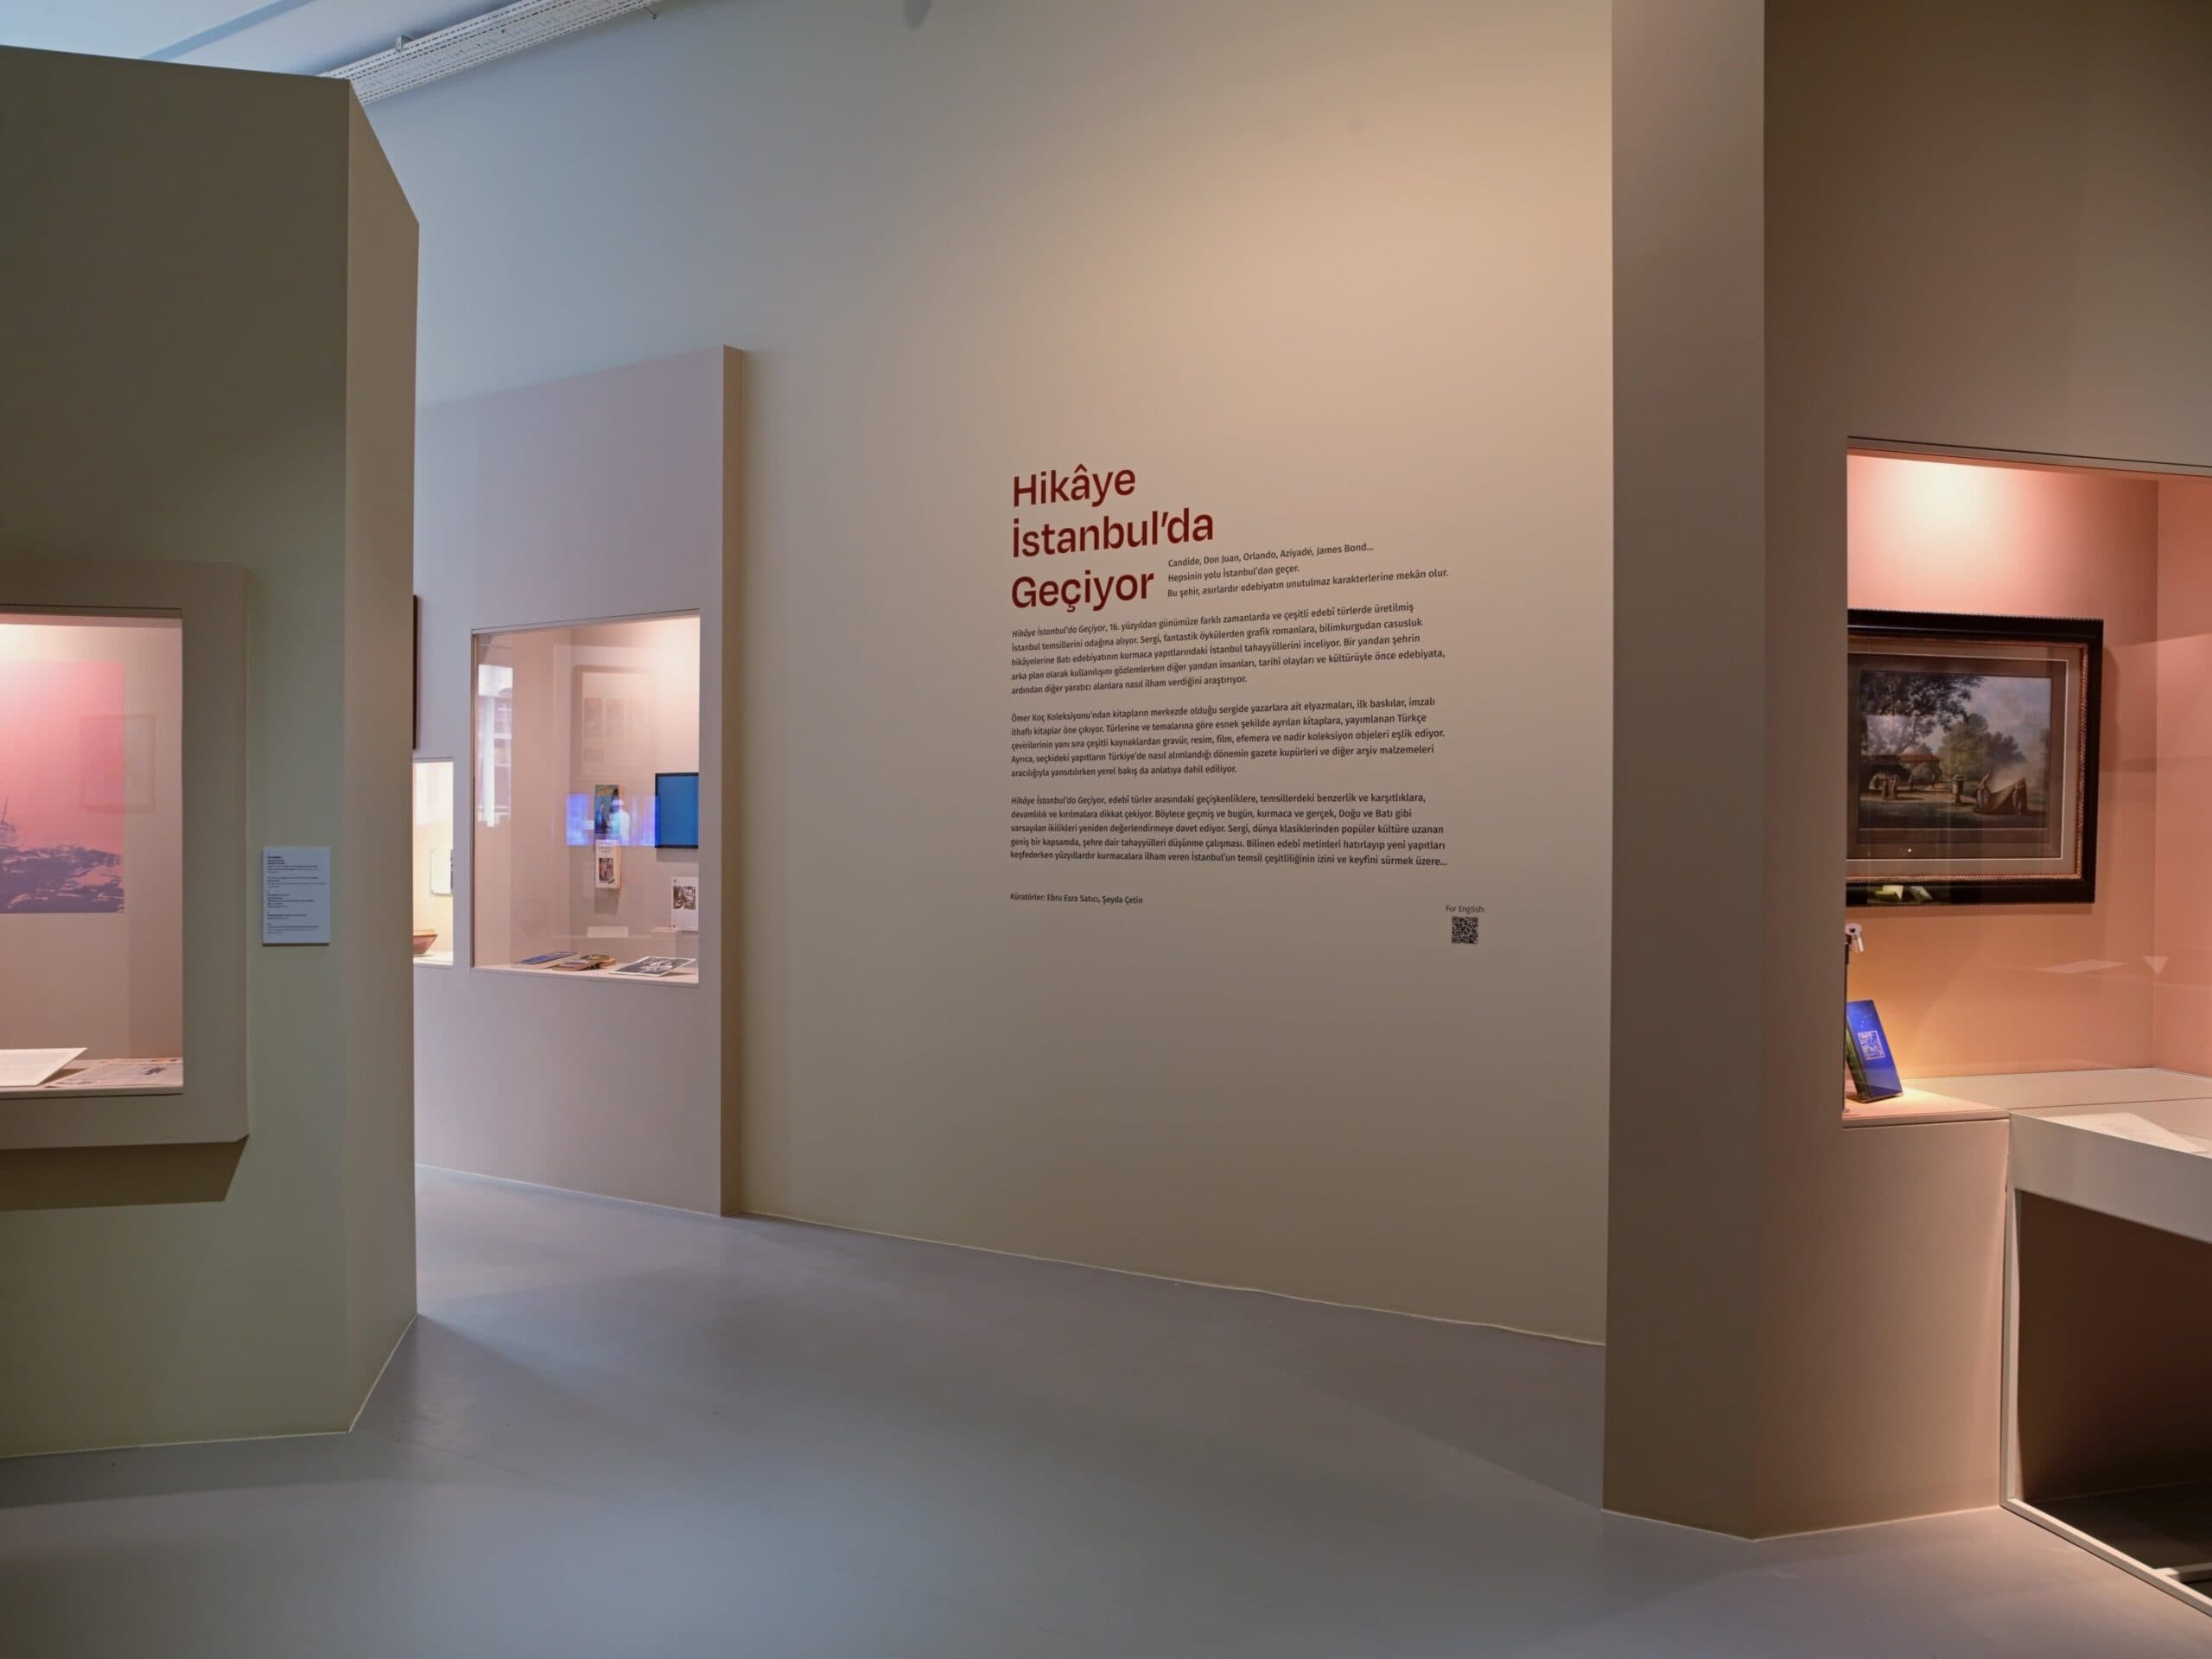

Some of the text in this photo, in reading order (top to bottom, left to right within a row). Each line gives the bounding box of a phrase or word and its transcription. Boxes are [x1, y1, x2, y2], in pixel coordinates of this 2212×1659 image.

[1014, 463, 1135, 507] Hikâye
[1013, 507, 1213, 557] İstanbul'da
[1167, 556, 1202, 567] Candide,
[1220, 555, 1242, 563] Juan,
[1243, 550, 1279, 560] Orlando,
[1315, 546, 1343, 556] James
[1166, 588, 1178, 597] Bu
[1179, 587, 1201, 598] şehir,
[1201, 583, 1239, 594] asırlardır
[1240, 581, 1284, 592] edebiyatın
[1285, 577, 1331, 588] unutulmaz
[1332, 572, 1395, 584] karakterlerine
[1427, 568, 1449, 577] olur.
[1167, 571, 1202, 582] Hepsinin
[1203, 569, 1222, 581] yolu
[1274, 565, 1300, 575] geçer.
[1012, 569, 1154, 613] Geçiyor
[1158, 617, 1198, 629] günümüze
[1199, 615, 1221, 624] farklı
[1222, 612, 1270, 623] zamanlarda
[1283, 608, 1309, 620] çeşitli
[1336, 605, 1372, 615] türlerde
[1374, 601, 1414, 613] üretilmiş
[1162, 632, 1198, 641] fantastik
[1198, 628, 1245, 641] öykülerden
[1245, 626, 1270, 639] grafik
[1271, 625, 1318, 634] romanlara,
[1319, 620, 1382, 632] bilimkurgudan
[1382, 617, 1422, 628] casusluk
[1153, 645, 1208, 659] yapıtlarındaki
[1209, 644, 1243, 654] İstanbul
[1243, 639, 1301, 652] tahayyüllerini
[1302, 638, 1342, 649] inceliyor.
[1343, 637, 1356, 646] Bir
[1357, 635, 1390, 647] yandan
[1391, 632, 1421, 645] şehrin
[1167, 676, 1203, 687] verdiğini
[1189, 705, 1217, 716] olduğu
[1218, 704, 1249, 715] sergide
[1249, 702, 1288, 714] yazarlara
[1289, 701, 1302, 710] ait
[1356, 698, 1368, 708] ilk
[1369, 698, 1407, 708] baskılar,
[1408, 697, 1435, 706] imzalı
[1167, 749, 1211, 760] alımlandığı
[1212, 748, 1249, 758] dönemin
[1249, 749, 1278, 759] gazete
[1279, 746, 1318, 758] kupürleri
[1331, 746, 1355, 757] diğer
[1355, 745, 1377, 757] arşiv
[1379, 744, 1434, 753] malzemeleri
[1150, 766, 1182, 775] anlatıya
[1182, 764, 1204, 773] dahil
[1205, 764, 1237, 774] ediliyor.
[1154, 809, 1185, 819] Böylece
[1185, 809, 1215, 819] geçmiş
[1227, 808, 1255, 819] bugün,
[1256, 809, 1293, 817] kurmaca
[1306, 808, 1337, 819] gerçek,
[1338, 808, 1361, 819] Doğu
[1375, 809, 1393, 817] Batı
[1394, 808, 1412, 819] gibi
[1166, 837, 1204, 849] düşünme
[1205, 838, 1244, 849] çalışması.
[1246, 838, 1275, 848] Bilinen
[1301, 838, 1341, 849] metinleri
[1343, 839, 1385, 850] hatırlayıp
[1386, 839, 1406, 850] yeni
[1407, 840, 1446, 851] yapıtları
[1236, 853, 1262, 861] temsil
[1264, 853, 1315, 864] çeşitliliğinin
[1317, 854, 1335, 863] izini
[1348, 855, 1378, 865] keyfini
[1380, 855, 1414, 864] sürmek
[1458, 905, 1486, 914] English:
